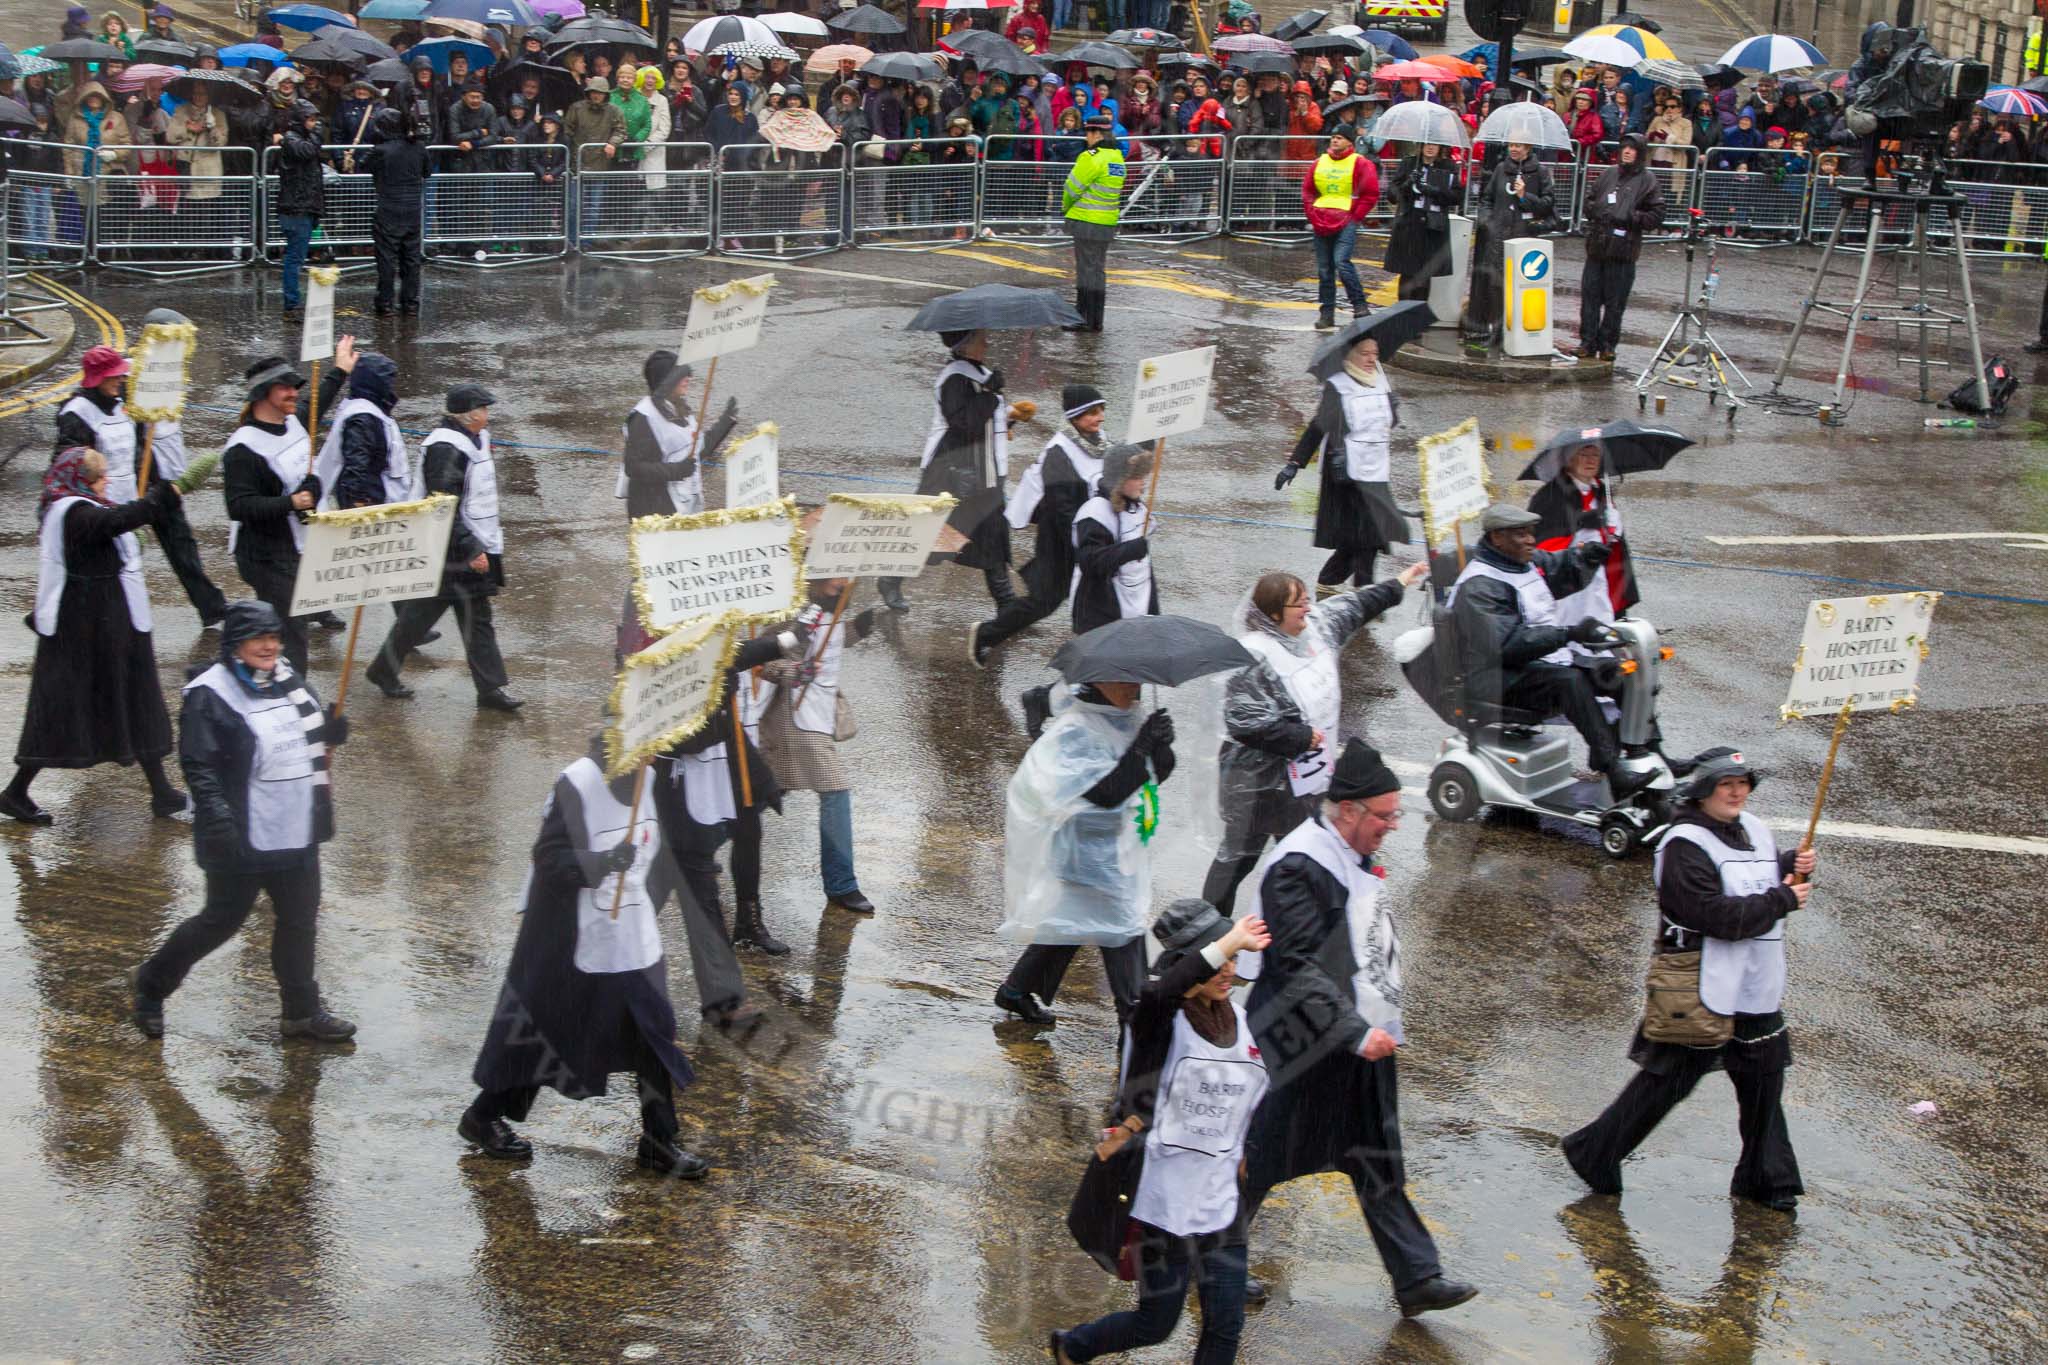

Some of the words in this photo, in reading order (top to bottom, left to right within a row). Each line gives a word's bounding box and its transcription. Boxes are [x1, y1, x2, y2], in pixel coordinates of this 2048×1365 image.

[350, 519, 410, 540] BART'S
[840, 525, 913, 538] HOSPITAL
[331, 538, 417, 562] HOSPITAL
[824, 541, 921, 554] VOLUNTEERS
[314, 555, 430, 583] VOLUNTEERS
[641, 557, 701, 580] BART'S
[706, 543, 790, 568] PATIENTS
[667, 563, 773, 593] NEWSPAPER
[670, 582, 775, 612] DELIVERIES
[1843, 615, 1896, 635] BART'S
[1825, 637, 1897, 659] HOSPITAL
[1808, 659, 1907, 682] VOLUNTEERS
